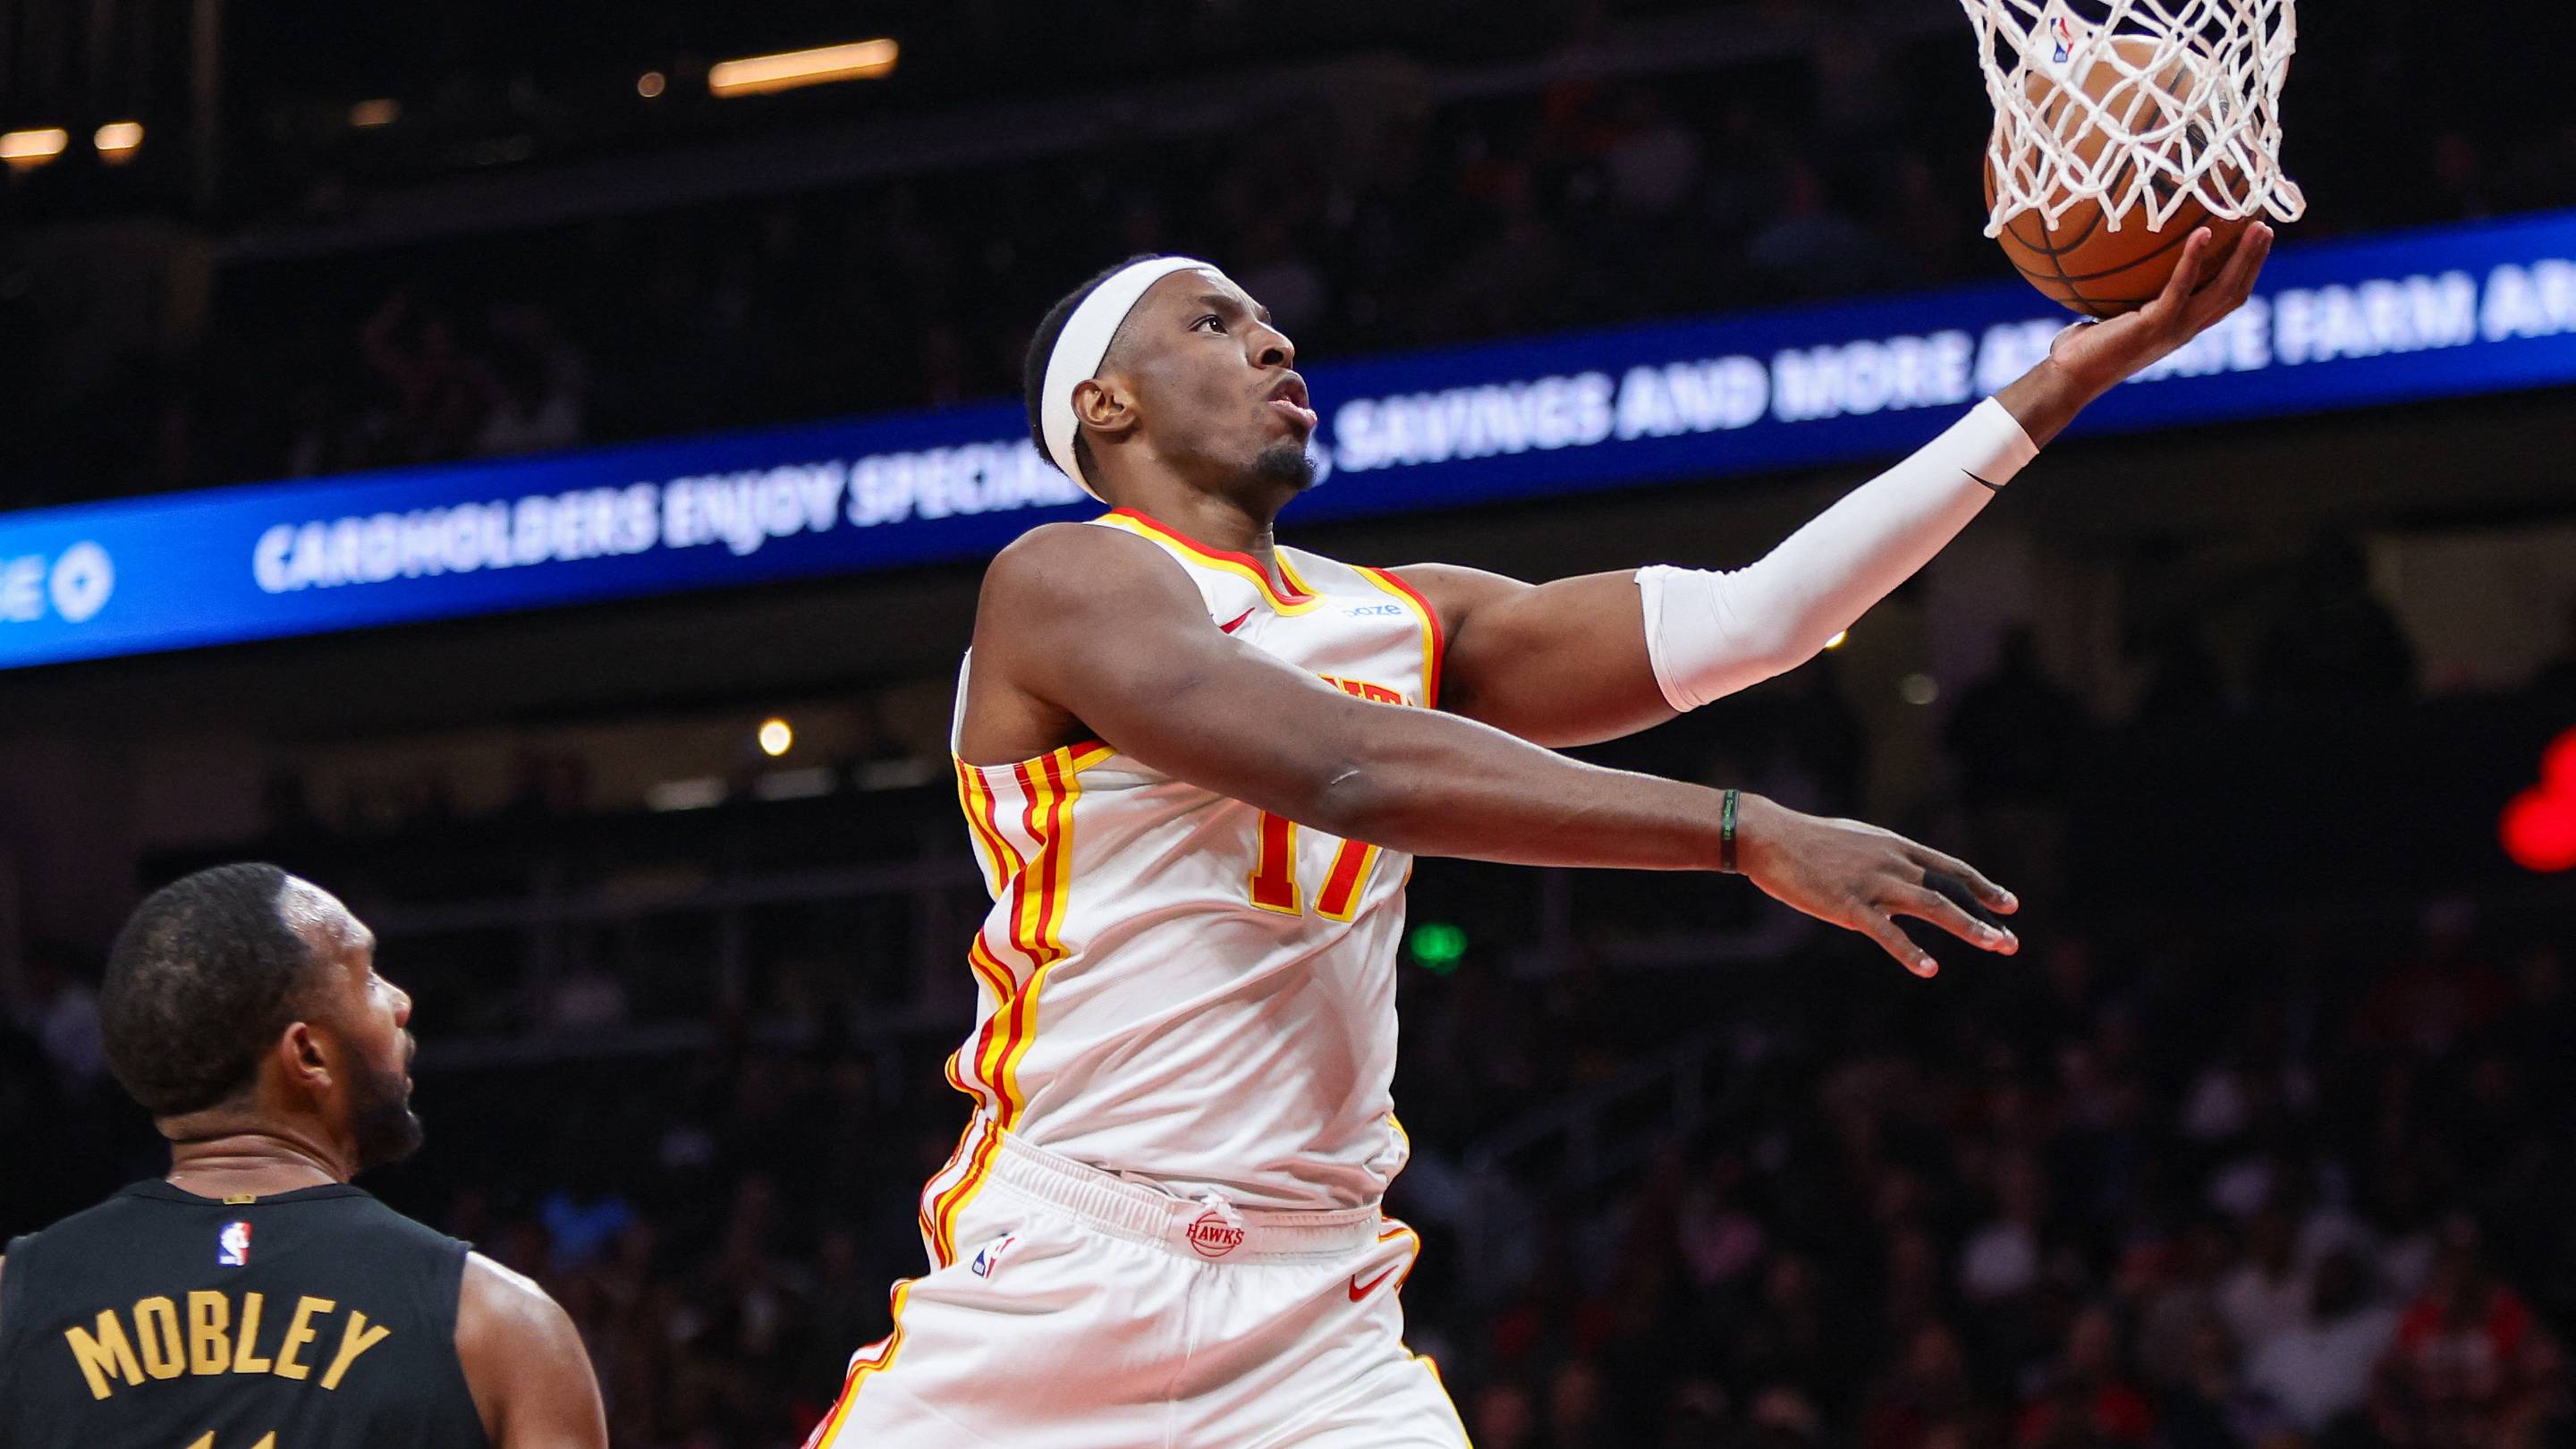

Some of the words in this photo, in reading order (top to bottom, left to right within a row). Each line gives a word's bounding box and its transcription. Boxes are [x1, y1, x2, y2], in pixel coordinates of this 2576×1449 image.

[254, 483, 660, 592] CARDHOLDERS
[660, 462, 846, 555] ENJOY
[1333, 372, 1612, 471] SAVINGS
[1614, 356, 1769, 440] AND
[1770, 331, 1973, 421] MORE
[2274, 271, 2477, 365] FARM
[1186, 1223, 1245, 1246] HAWKS
[64, 1291, 392, 1400] MOBLEY
